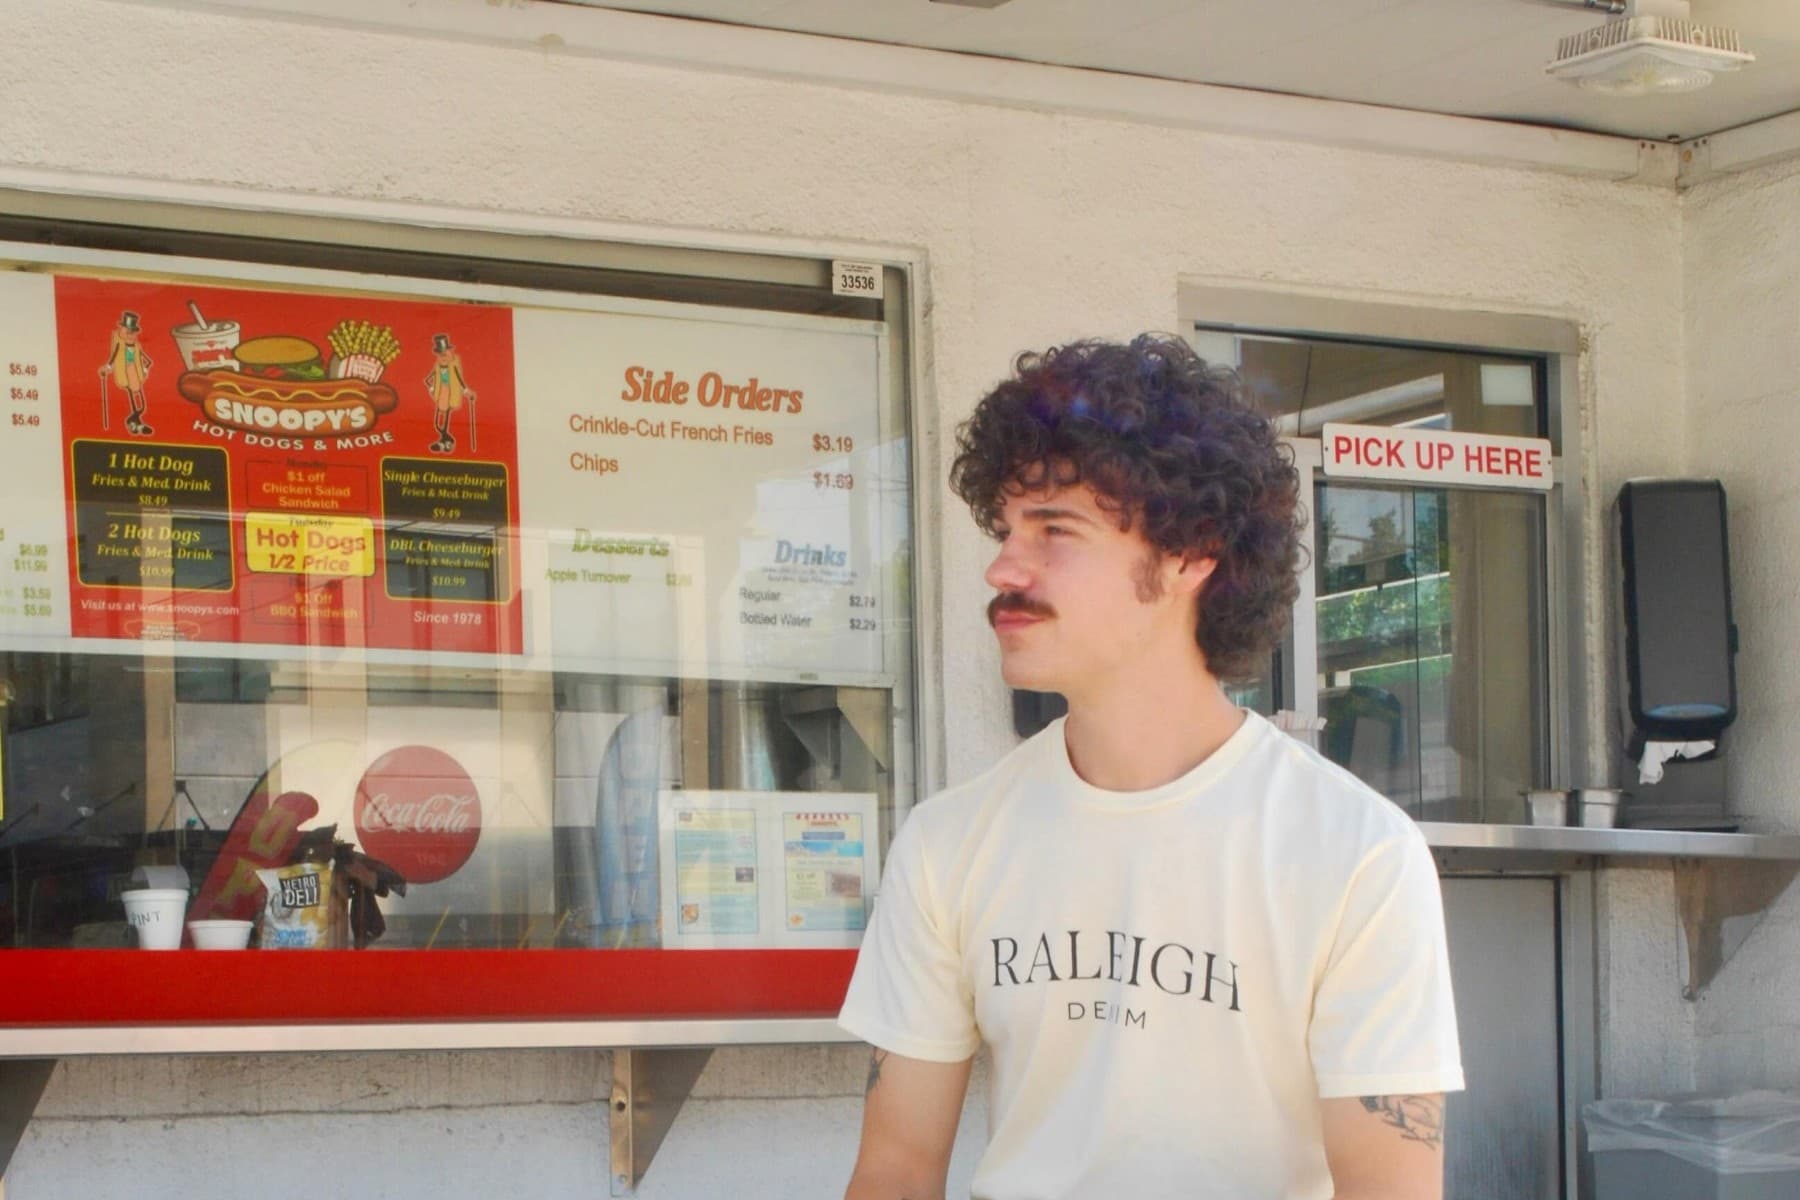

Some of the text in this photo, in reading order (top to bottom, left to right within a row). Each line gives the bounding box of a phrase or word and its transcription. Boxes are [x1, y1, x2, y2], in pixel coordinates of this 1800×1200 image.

[841, 273, 875, 290] 33536
[621, 366, 804, 414] Side Orders
[214, 398, 368, 431] SNOOPY'S
[193, 420, 394, 450] HOT DOGS & MORE
[569, 414, 773, 446] Crinkle-Cut French Fries
[812, 433, 853, 453] $3.19
[109, 453, 194, 475] 1 Hot Dog
[570, 452, 619, 475] Chips
[1334, 436, 1542, 477] PICK UP HERE
[92, 474, 126, 487] Fries
[128, 476, 138, 488] &
[174, 480, 212, 492] Drink
[308, 472, 326, 483] off
[384, 470, 505, 489] Single Cheeseburger
[263, 483, 351, 497] Chicken Salad
[279, 496, 339, 509] Sandwich
[108, 523, 201, 545] 2 Hot Dogs
[256, 527, 366, 556] Hot Dogs
[97, 544, 129, 556] Fries
[132, 546, 141, 557] &
[176, 548, 214, 561] Drink
[774, 539, 847, 567] Drinks
[269, 553, 351, 573] 1/2 Price
[544, 568, 632, 584] Apple Turnover
[739, 586, 781, 602] Regular
[80, 600, 106, 611] Visit
[108, 602, 122, 611] us
[124, 602, 136, 611] at
[413, 610, 482, 625] Since 1978
[740, 612, 812, 627] Bottled Water
[282, 875, 317, 892] METRO
[285, 888, 317, 906] DELI
[130, 911, 161, 927] PINT
[991, 930, 1242, 1011] RALEIGH
